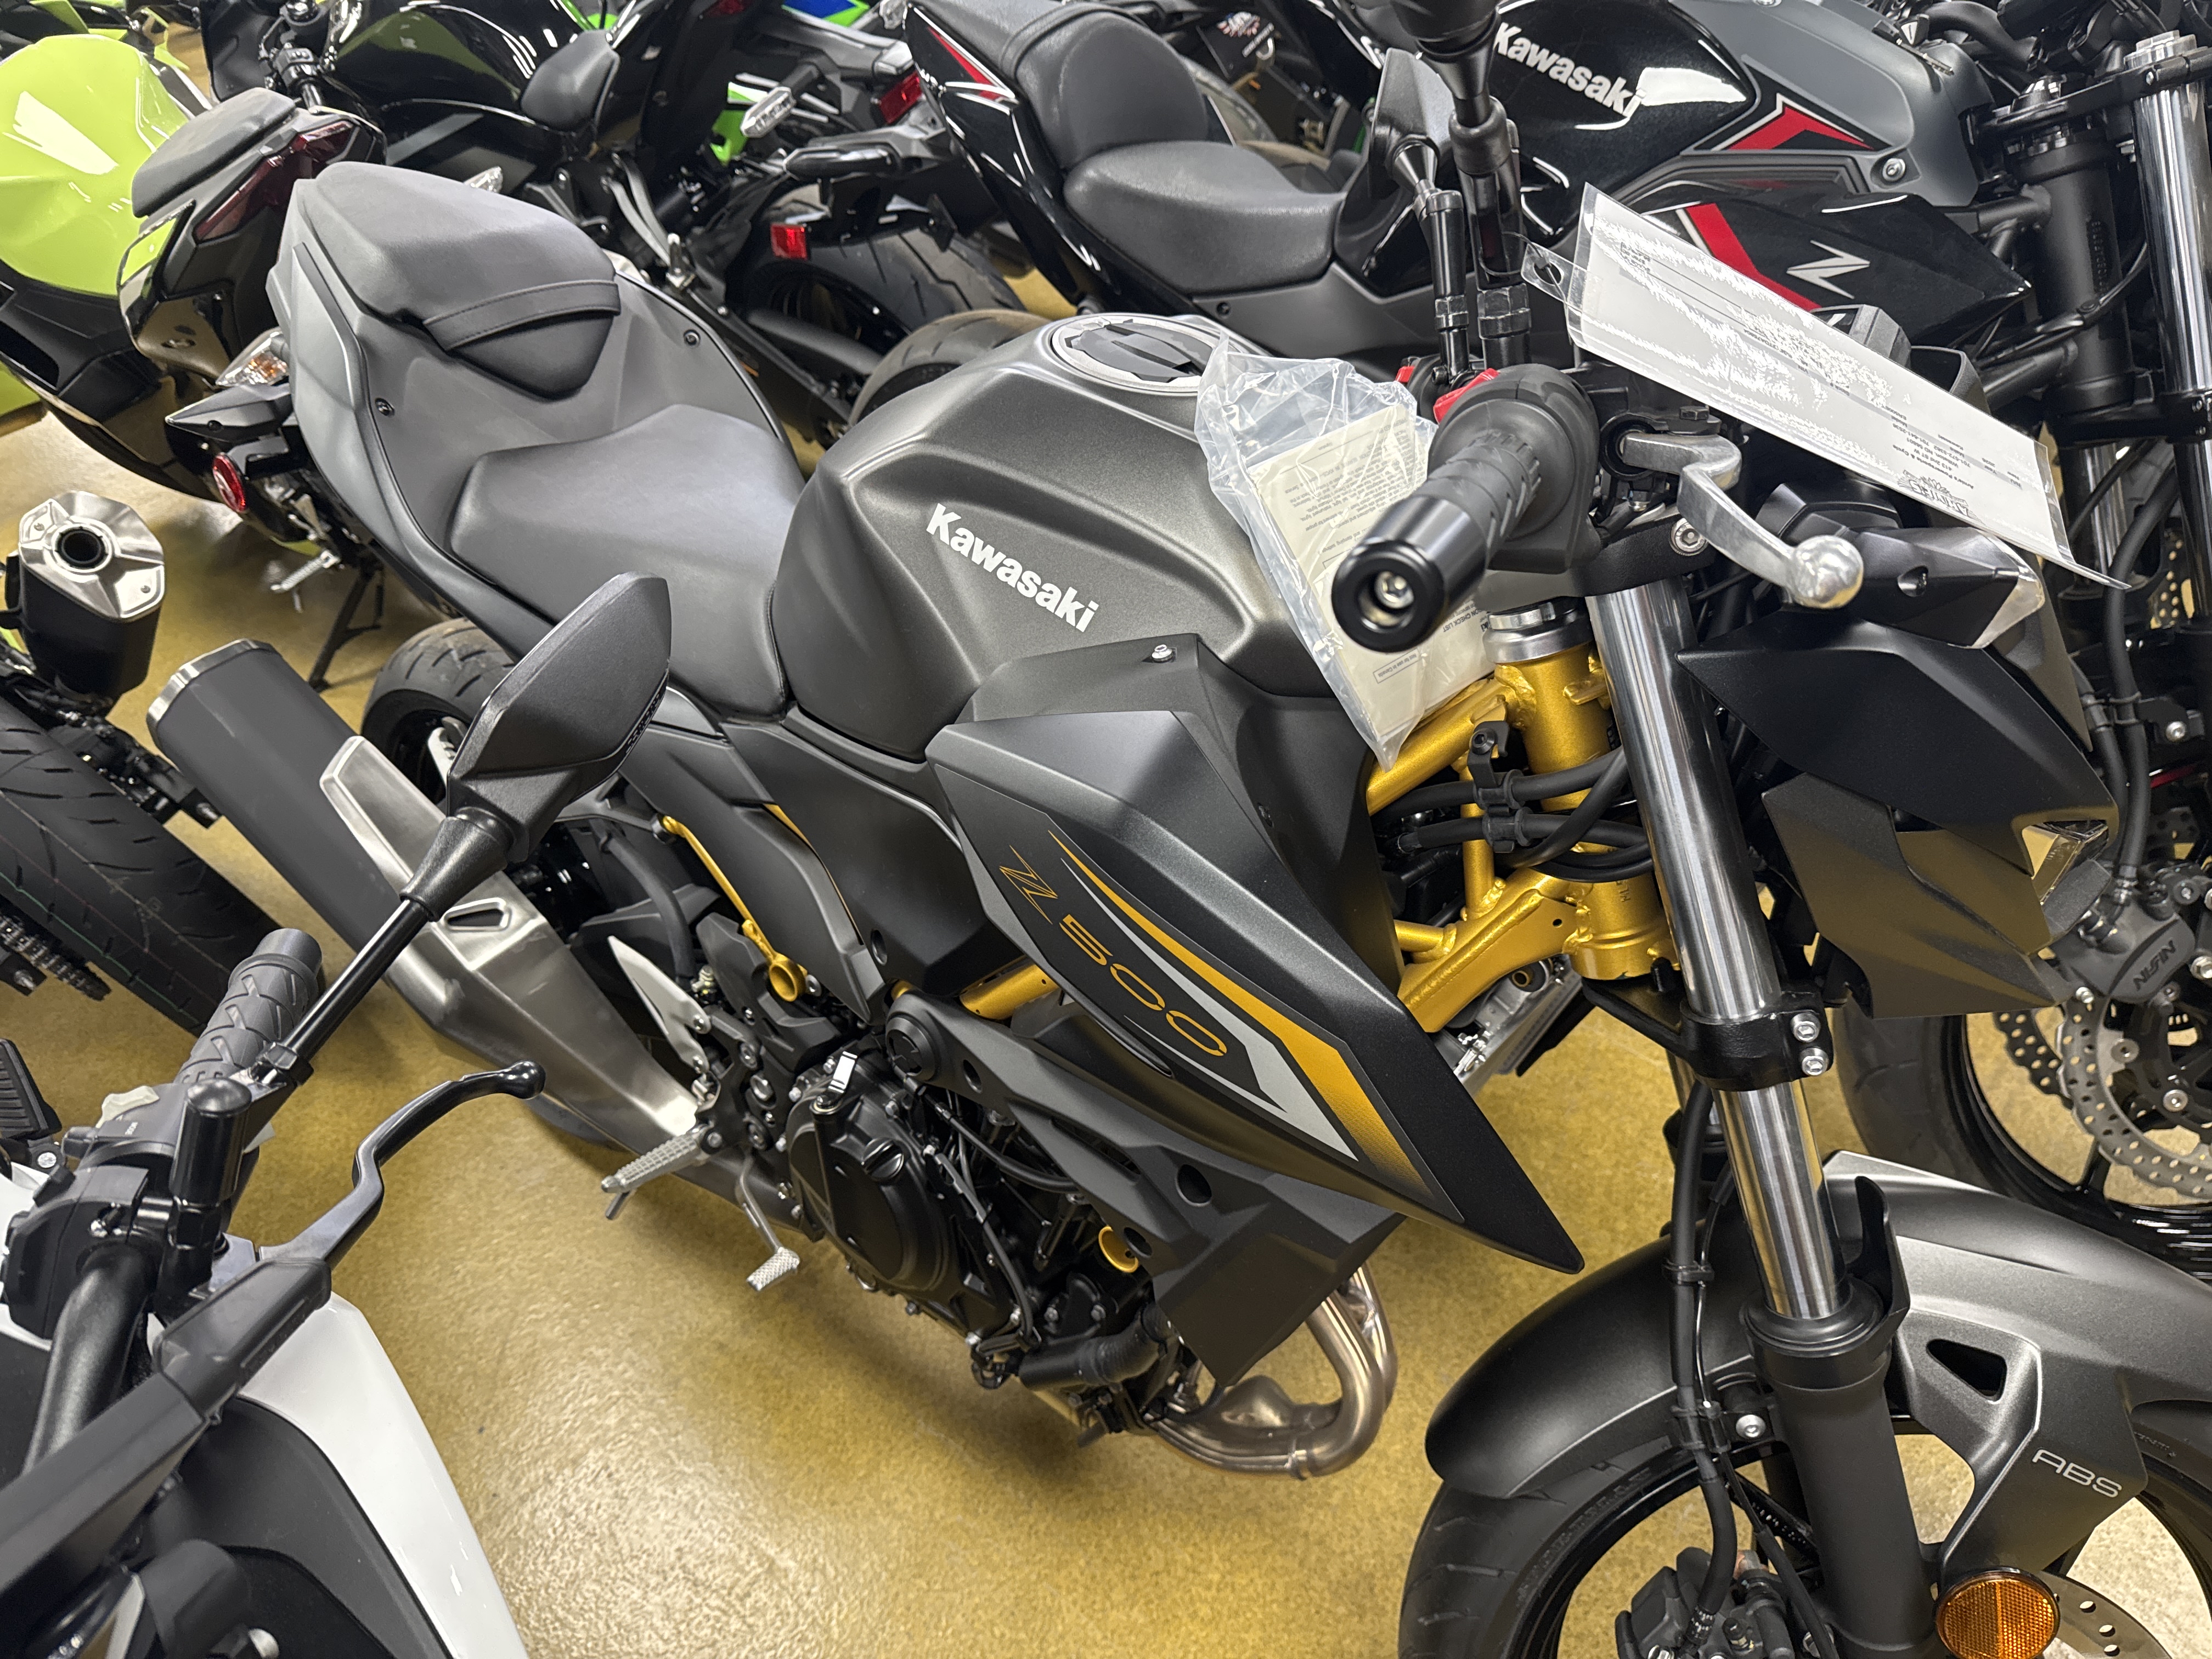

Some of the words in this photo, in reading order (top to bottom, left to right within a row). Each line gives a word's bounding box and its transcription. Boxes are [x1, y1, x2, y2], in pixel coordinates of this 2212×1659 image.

[1493, 22, 1646, 117] Kawasaki
[1893, 444, 1909, 456] Cycle
[926, 503, 1099, 632] Kawasaki
[1443, 622, 1453, 632] LIST
[1454, 613, 1471, 625] CHECK
[1378, 667, 1393, 677] Canada
[1060, 913, 1228, 1057] 500
[2132, 939, 2176, 991] NISSIN
[2032, 1447, 2123, 1498] ABS
